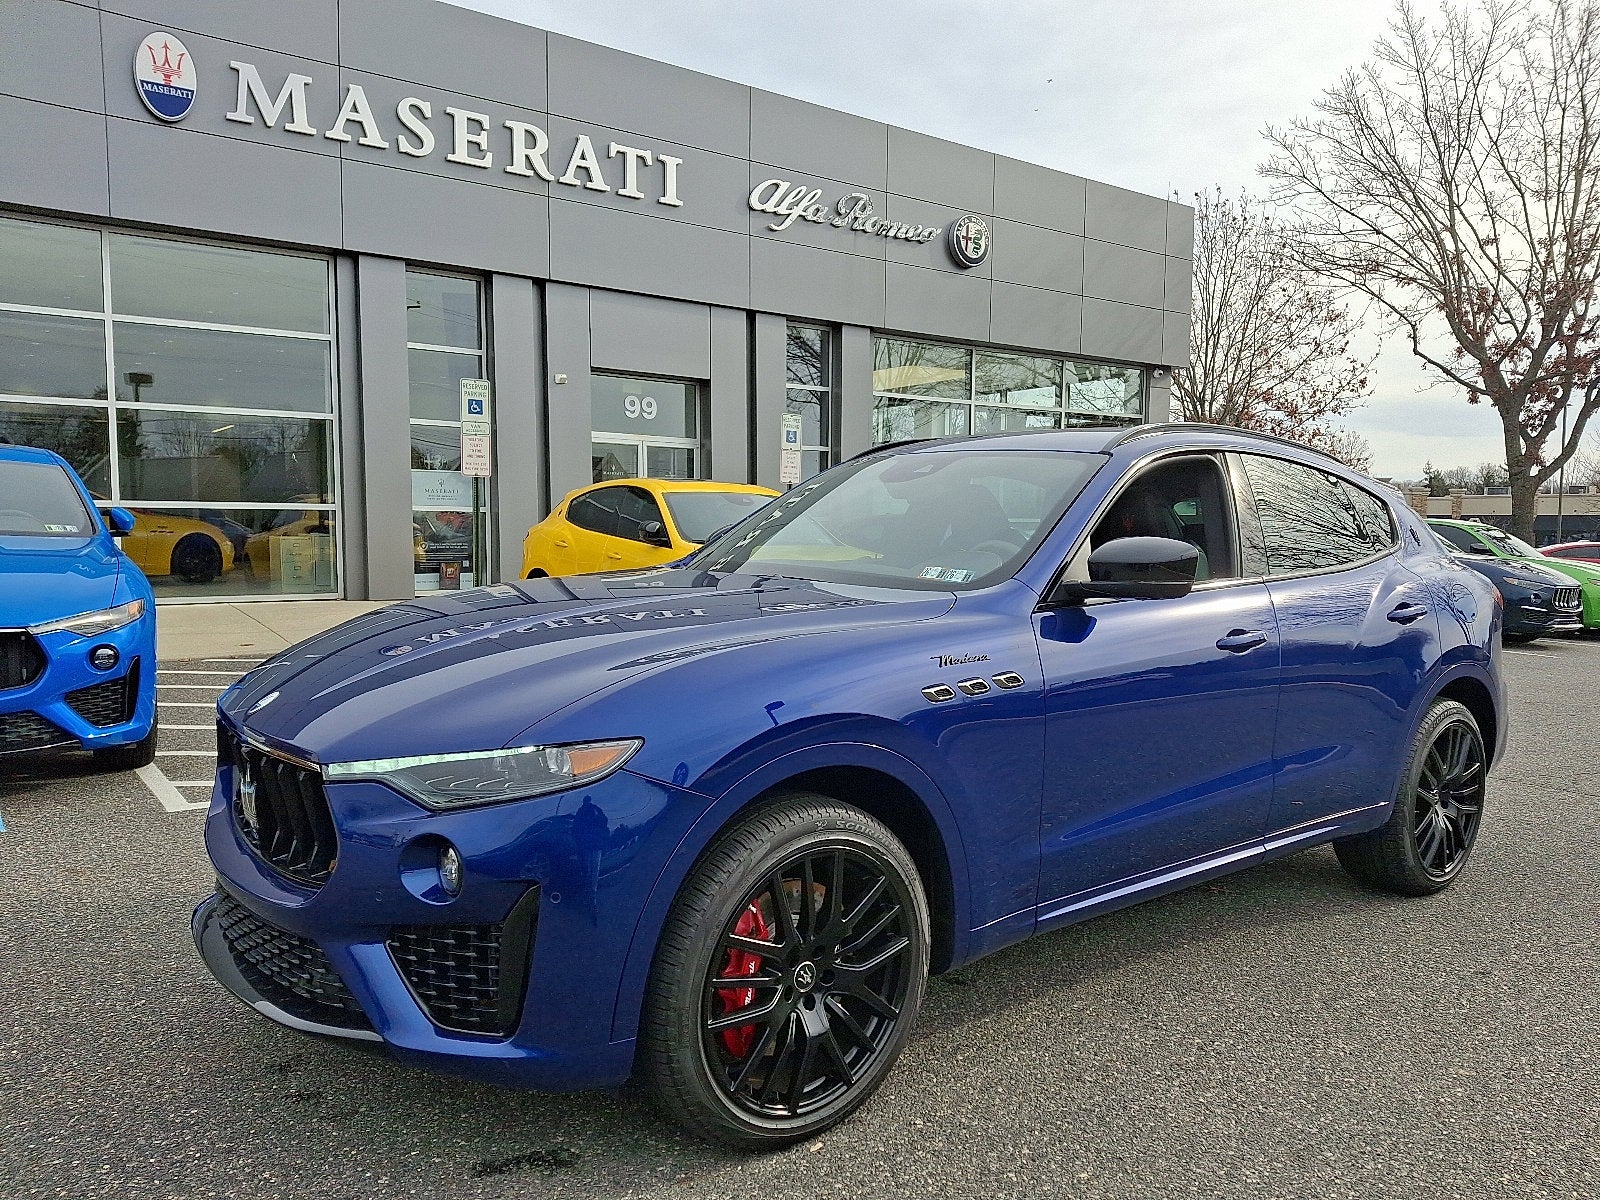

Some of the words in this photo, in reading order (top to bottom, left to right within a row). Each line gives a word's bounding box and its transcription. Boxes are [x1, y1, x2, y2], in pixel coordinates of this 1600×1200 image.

[143, 82, 192, 99] MASERATI
[225, 60, 684, 207] MASERATI
[749, 179, 833, 231] Alfa
[831, 193, 942, 243] Romeo
[956, 217, 970, 236] ALFA
[624, 395, 658, 420] 99
